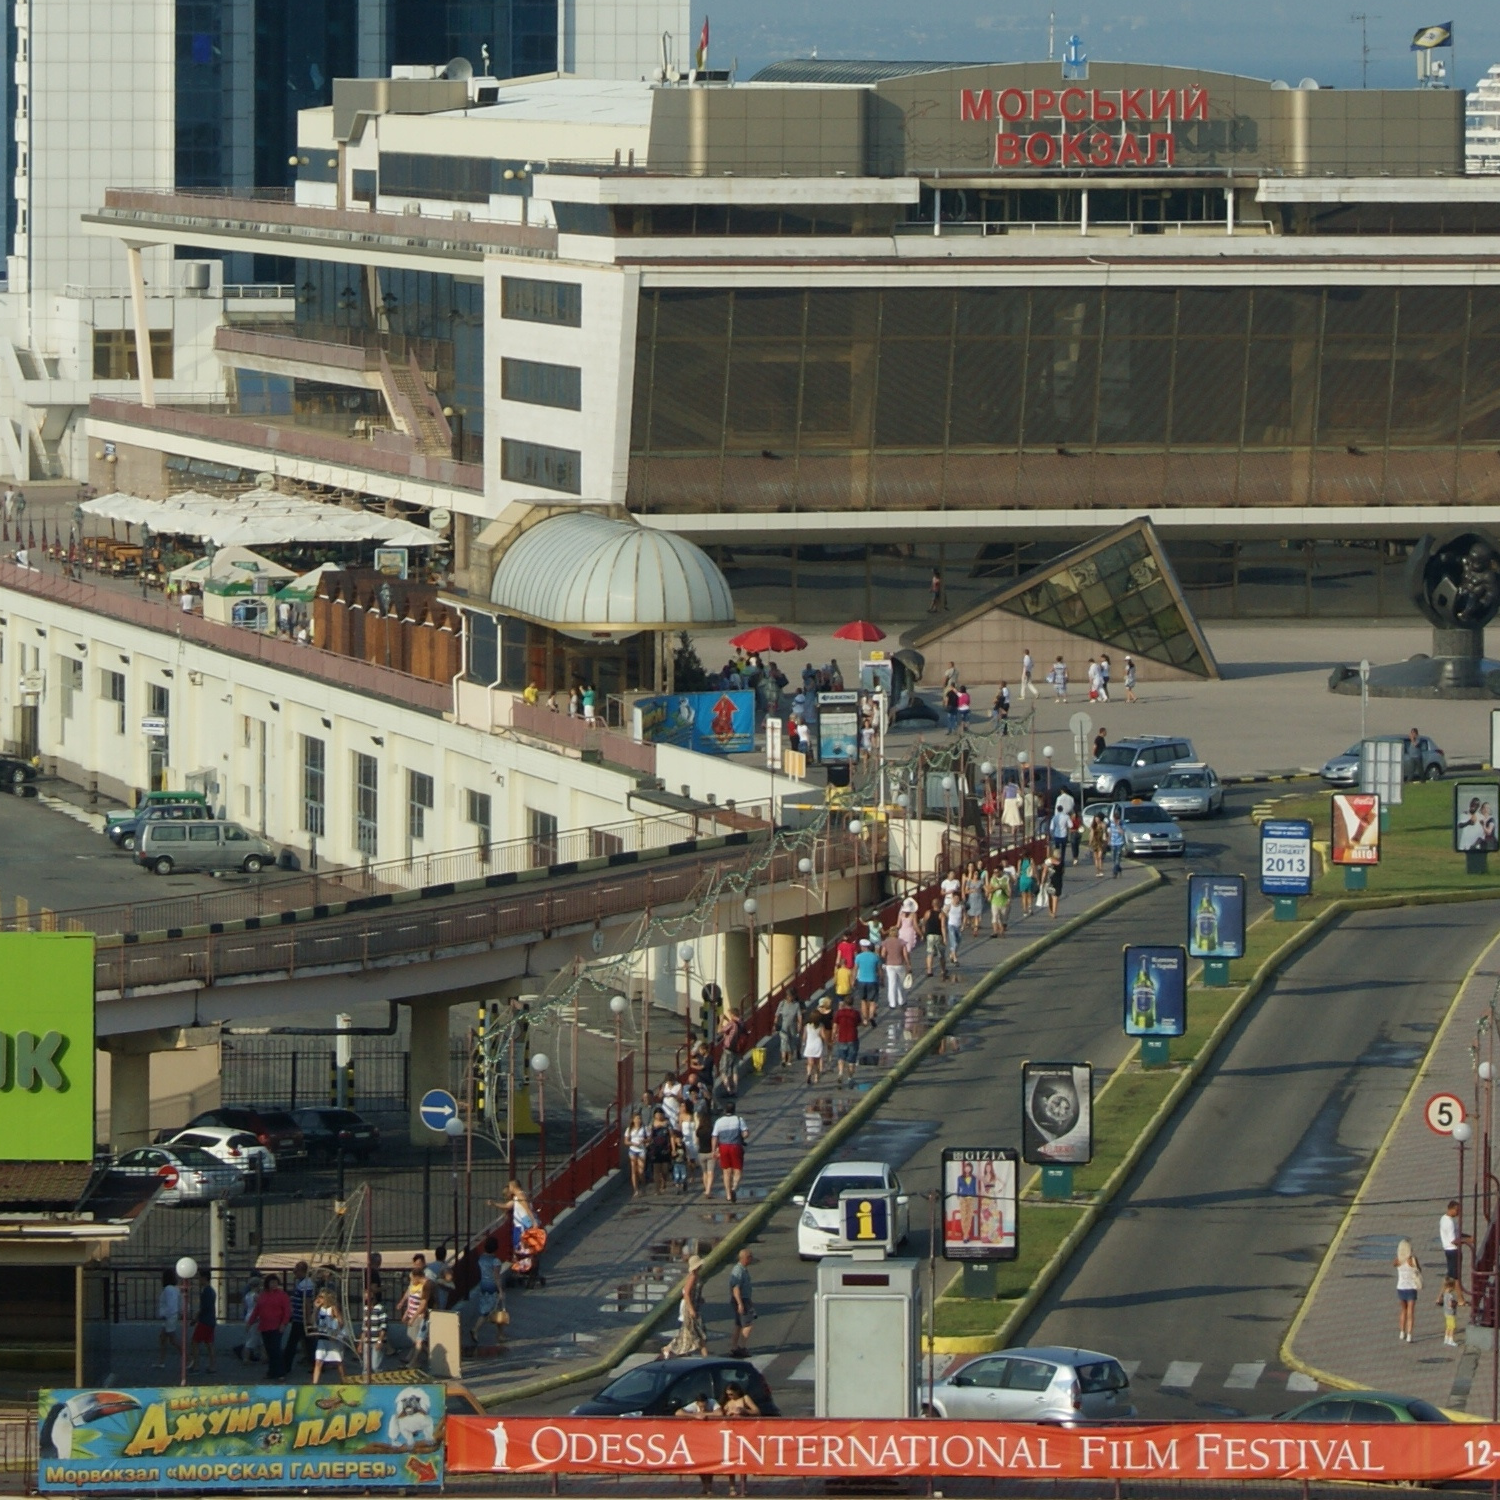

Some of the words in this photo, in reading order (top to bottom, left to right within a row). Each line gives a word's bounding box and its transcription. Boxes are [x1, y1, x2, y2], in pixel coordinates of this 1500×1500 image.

[961, 83, 1208, 122] МОРСЬКИЙ
[997, 132, 1175, 166] ВОКЗАЛ
[1265, 857, 1306, 873] 2013
[1437, 1102, 1454, 1127] 5
[965, 1151, 1006, 1161] GIZIA
[292, 1408, 385, 1449] ПАРК
[529, 1425, 695, 1465] ODESSA
[719, 1429, 1062, 1469] INTERNATIONAL
[1079, 1435, 1180, 1470] FILM
[1195, 1432, 1385, 1471] FESTIVAL
[45, 1464, 160, 1485] Морвокзал
[166, 1462, 284, 1482] «МОРСКАЯ
[290, 1461, 398, 1480] ГАЛЕРЕЯ»
